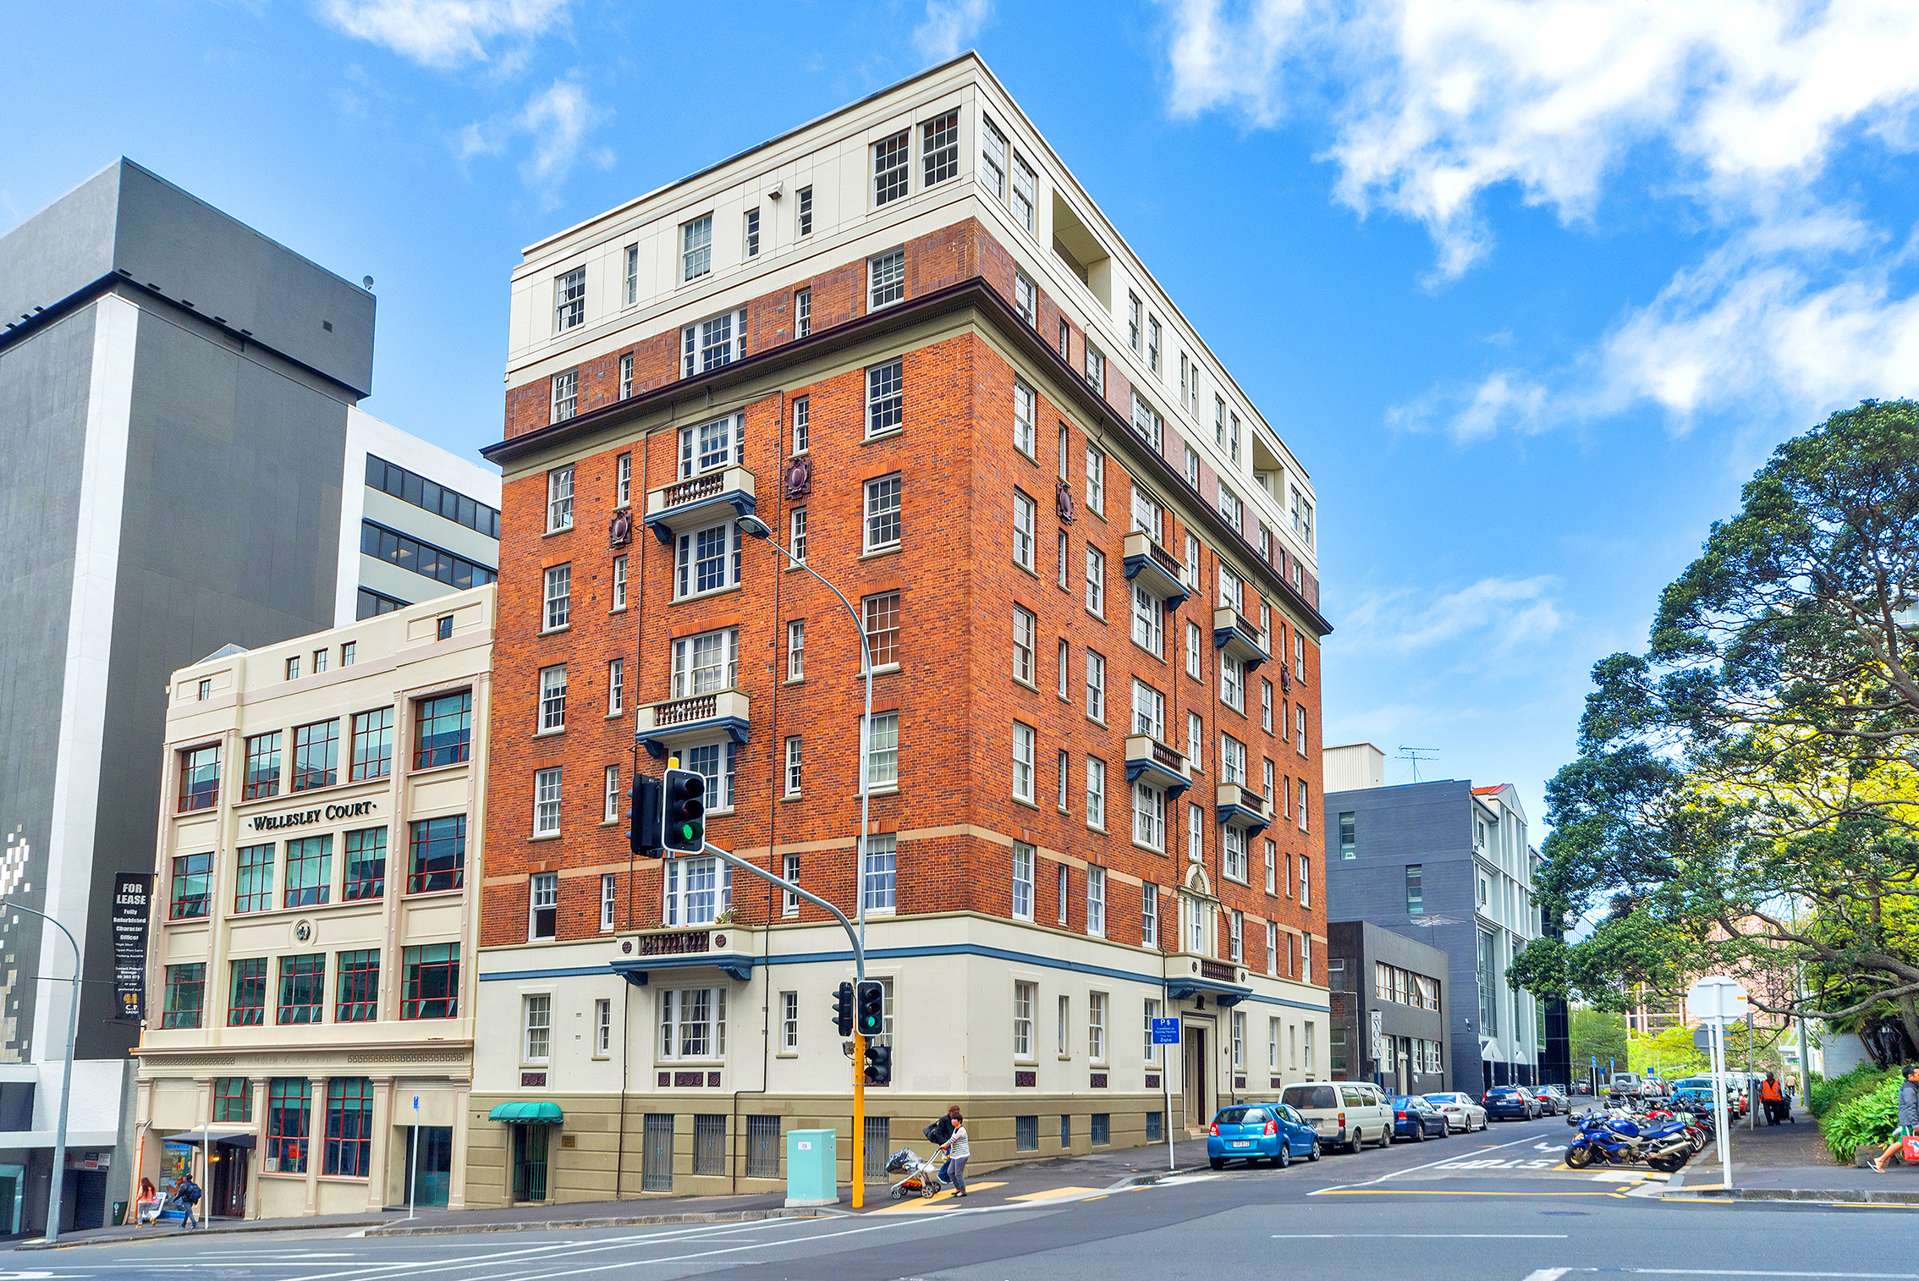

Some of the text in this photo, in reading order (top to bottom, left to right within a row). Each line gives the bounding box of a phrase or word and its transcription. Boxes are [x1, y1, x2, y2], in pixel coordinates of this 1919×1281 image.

[253, 801, 371, 831] WELLESLEY COURT
[122, 883, 142, 893] FOR
[116, 895, 146, 904] LEASE
